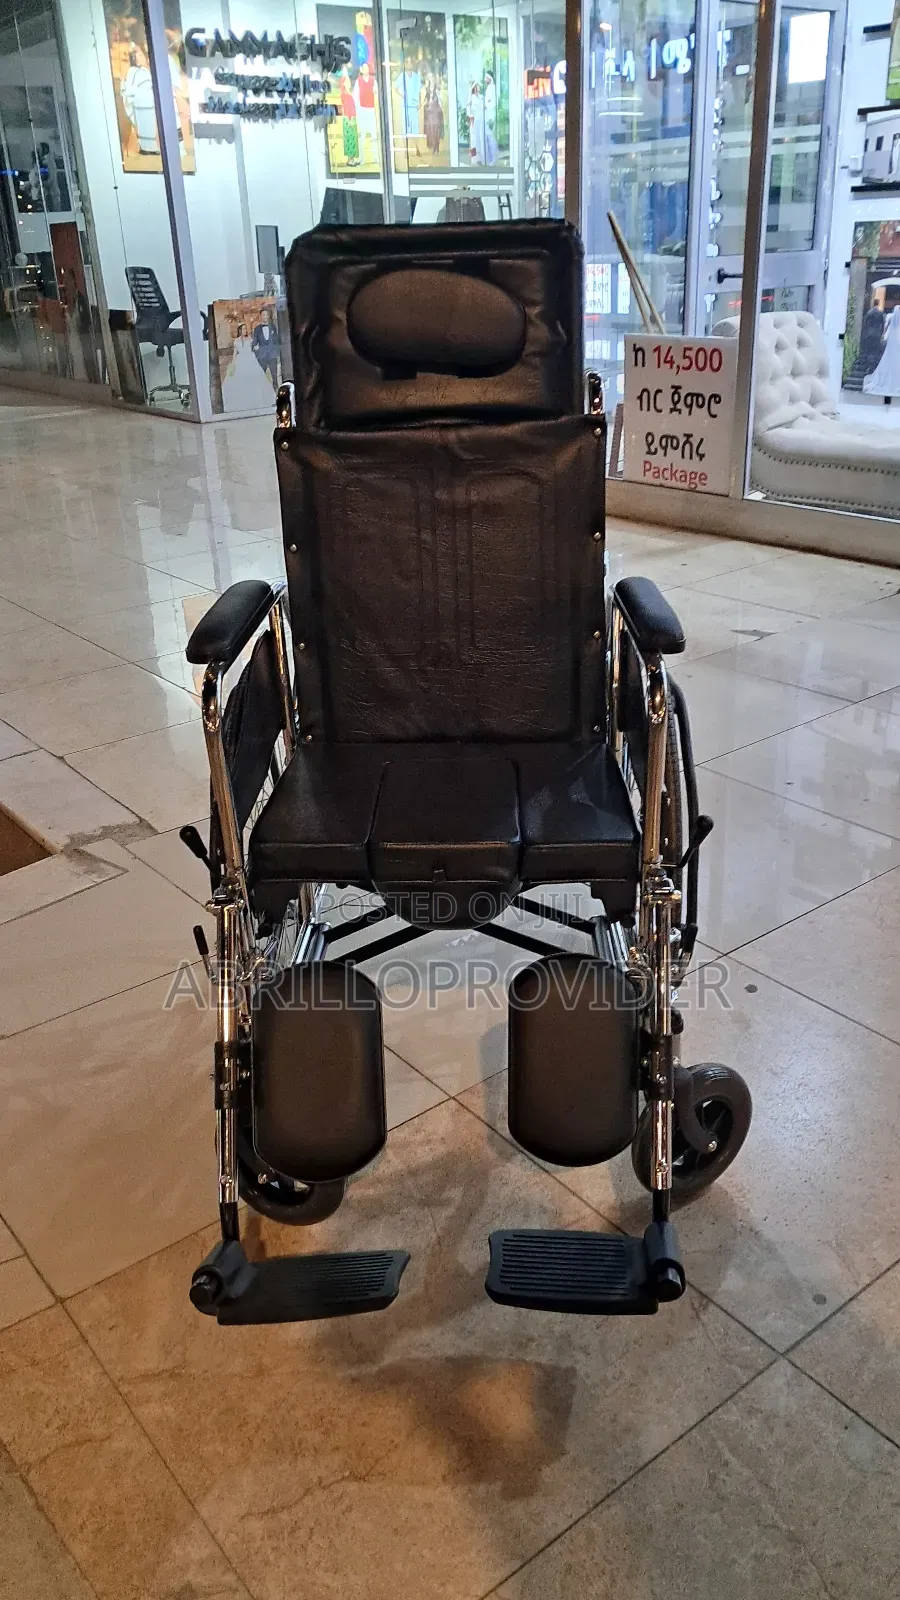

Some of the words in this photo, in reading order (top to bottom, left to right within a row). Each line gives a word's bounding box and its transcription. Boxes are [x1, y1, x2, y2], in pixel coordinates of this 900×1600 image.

[633, 343, 646, 368] ከ
[653, 344, 723, 375] 14,500
[637, 387, 664, 414] ብር
[669, 384, 722, 419] ጀምሮ
[642, 459, 708, 491] Package
